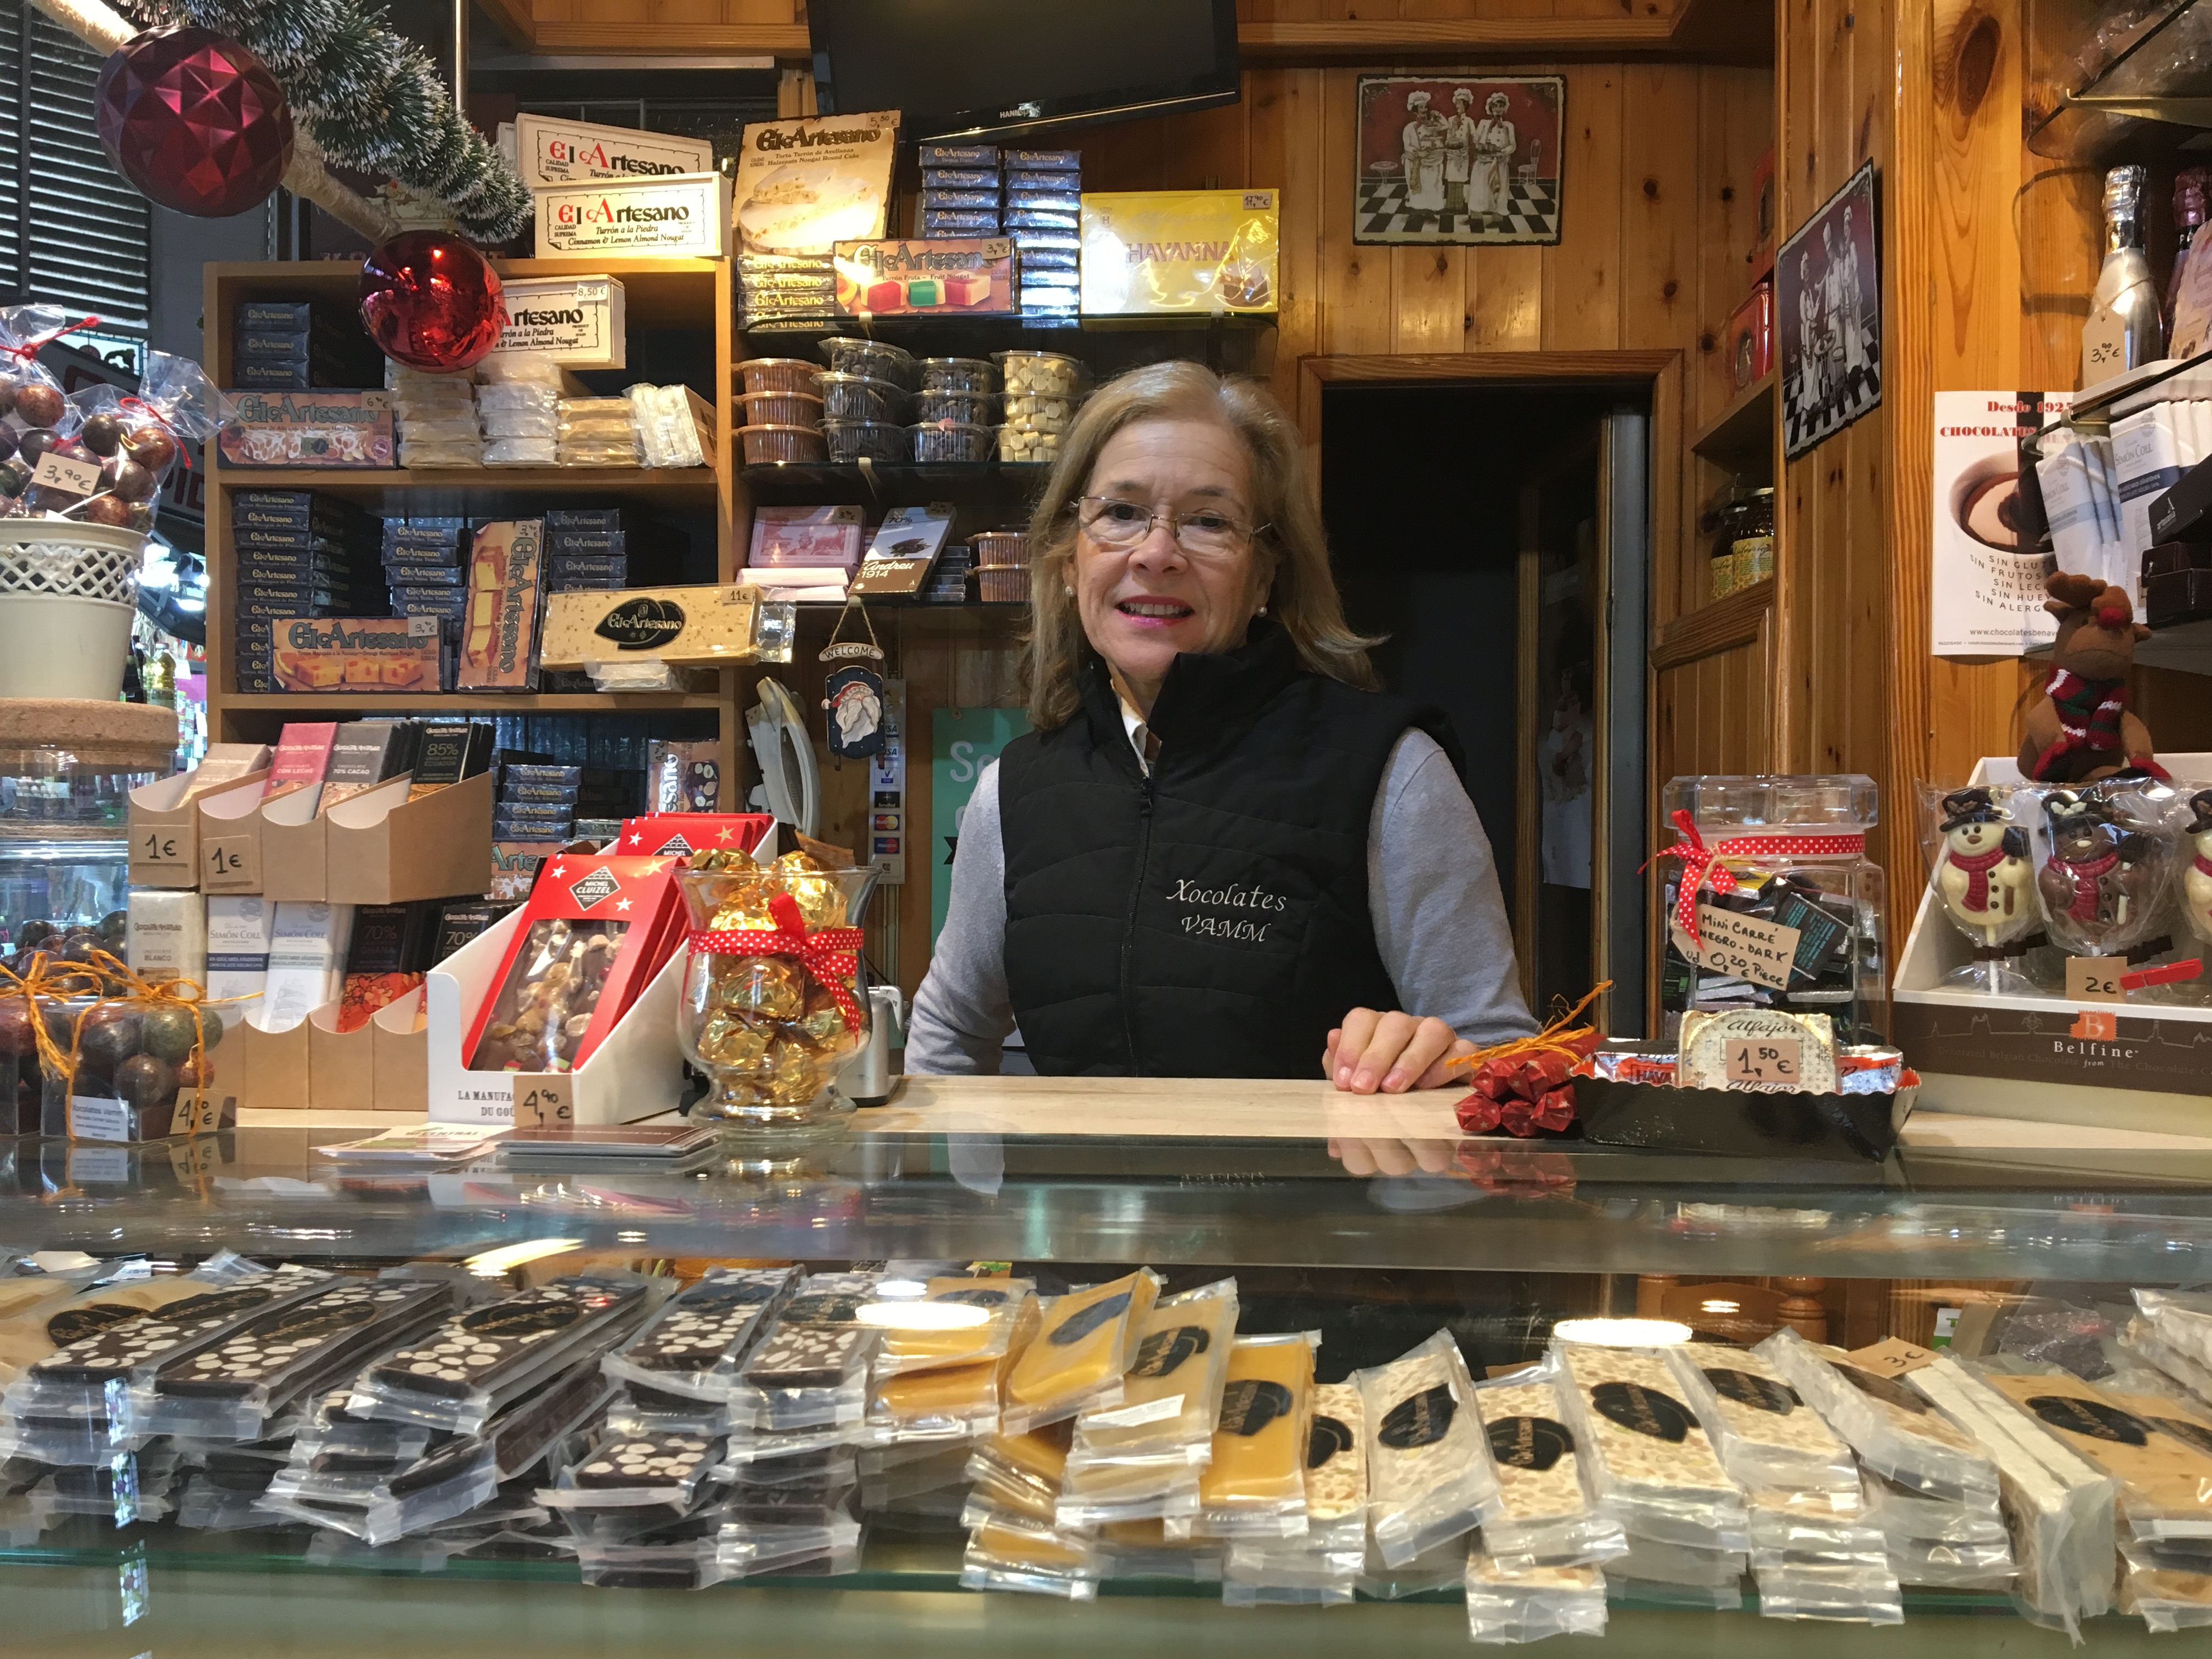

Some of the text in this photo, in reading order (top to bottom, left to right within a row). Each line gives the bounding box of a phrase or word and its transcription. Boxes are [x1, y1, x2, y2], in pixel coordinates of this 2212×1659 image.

[782, 125, 881, 149] Artesano
[549, 140, 685, 174] El Artesano
[558, 198, 689, 225] El Artesano
[596, 226, 617, 235] Turrón
[633, 234, 658, 242] Almond
[660, 233, 684, 242] Nougat
[1126, 241, 1234, 263] HAVANNA
[578, 287, 606, 297] 8,50 €
[755, 292, 823, 306] El Artesano
[532, 328, 554, 336] Piedra
[530, 337, 554, 346] Almond
[556, 337, 578, 346] Nougat
[237, 394, 380, 424] El Artesano
[1987, 401, 2031, 413] Desde
[2136, 443, 2153, 458] COLL
[569, 516, 606, 524] Artesano
[407, 528, 443, 537] Artesano
[574, 538, 612, 546] Artesano
[405, 548, 440, 557] Artesano
[575, 561, 613, 571] Artesano
[864, 561, 915, 571] Andreu
[1970, 554, 2041, 580] SIN FRUTOS
[1989, 555, 2057, 569] SIN GLUTE
[410, 567, 445, 576] Artesano
[1994, 578, 2012, 589] SIN
[1975, 590, 1993, 605] SIN
[1991, 589, 2010, 599] SIN
[416, 605, 452, 613] Artesano
[499, 563, 534, 673] Artesano
[608, 613, 682, 630] El Artesano
[289, 622, 428, 650] El Artesano
[823, 645, 875, 658] WELCOME
[427, 743, 459, 755] 85%
[145, 834, 177, 860] 1€
[212, 847, 242, 874] 1€
[1166, 879, 1286, 911] Xocolates
[210, 929, 261, 939] SIMÓN COLL
[304, 929, 325, 938] COLL
[364, 926, 397, 940] 70%
[1182, 915, 1272, 942] VAMM
[1748, 944, 1788, 963] DARK
[2084, 976, 2118, 995] 2€
[1726, 1019, 1798, 1038] Alfajor
[2053, 1041, 2134, 1058] Belfine
[1938, 1046, 2195, 1075] Decorated Belgian Chocolate from The Chocolate
[458, 1091, 514, 1101] LA MANUFA
[481, 1106, 515, 1117] DU GOÛ
